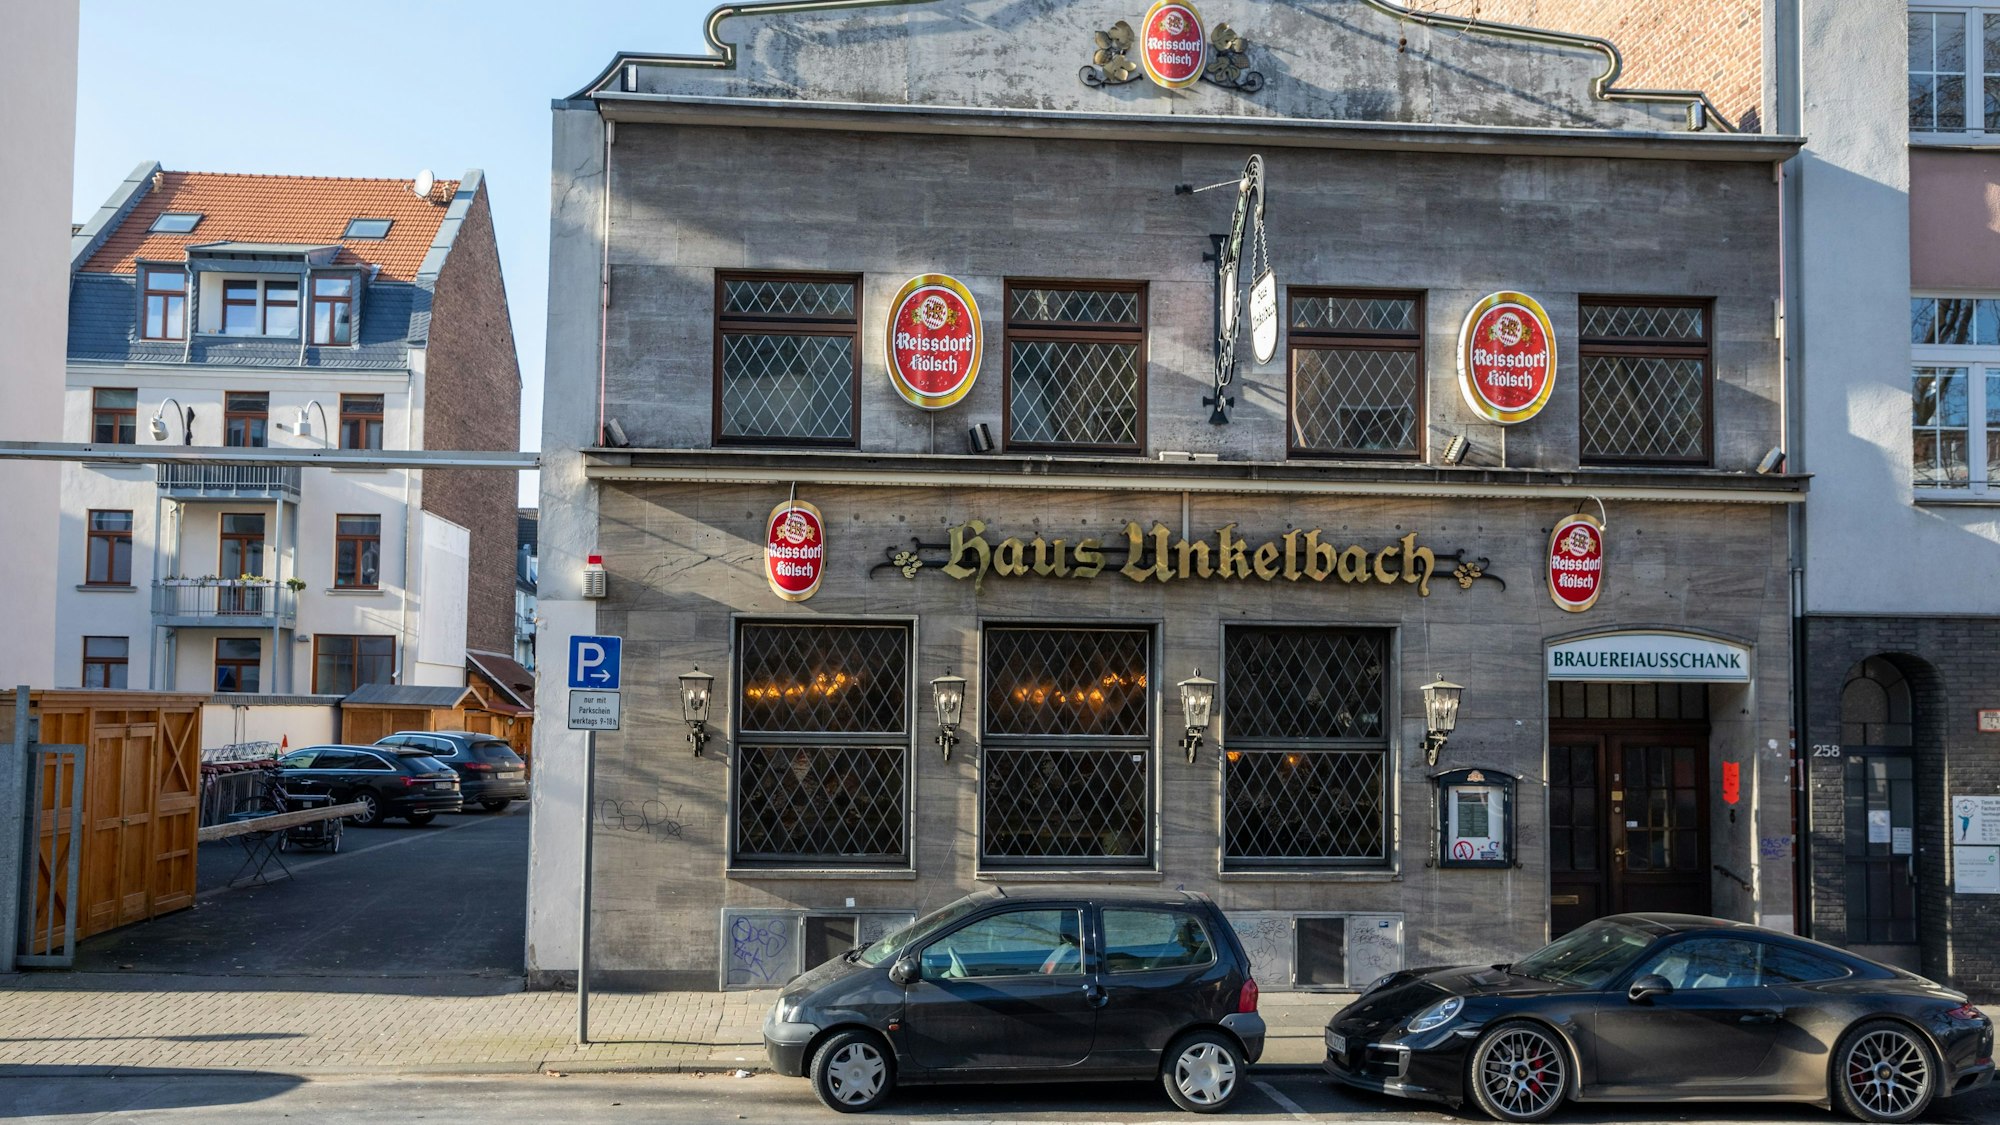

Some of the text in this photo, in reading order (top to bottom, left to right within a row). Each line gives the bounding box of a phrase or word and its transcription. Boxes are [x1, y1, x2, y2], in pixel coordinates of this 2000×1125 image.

[1148, 37, 1201, 52] Reissdorf
[1158, 52, 1192, 67] Kölsch
[896, 332, 972, 352] Reissdorf
[910, 354, 957, 374] Kölsch
[1473, 348, 1548, 367] Reissdorf
[1487, 369, 1532, 390] Kölsch
[769, 542, 822, 560] Reissdorf
[941, 520, 1436, 597] Haus Unkelbach
[776, 561, 813, 579] Kölsch
[1552, 555, 1601, 571] Reissdorf
[1558, 573, 1594, 590] Kölsch
[577, 642, 605, 681] P
[1554, 651, 1741, 669] BRAUEREIAUSSCHANK
[579, 706, 610, 715] Parkschein
[572, 718, 598, 726] werktags
[1813, 745, 1840, 757] 258
